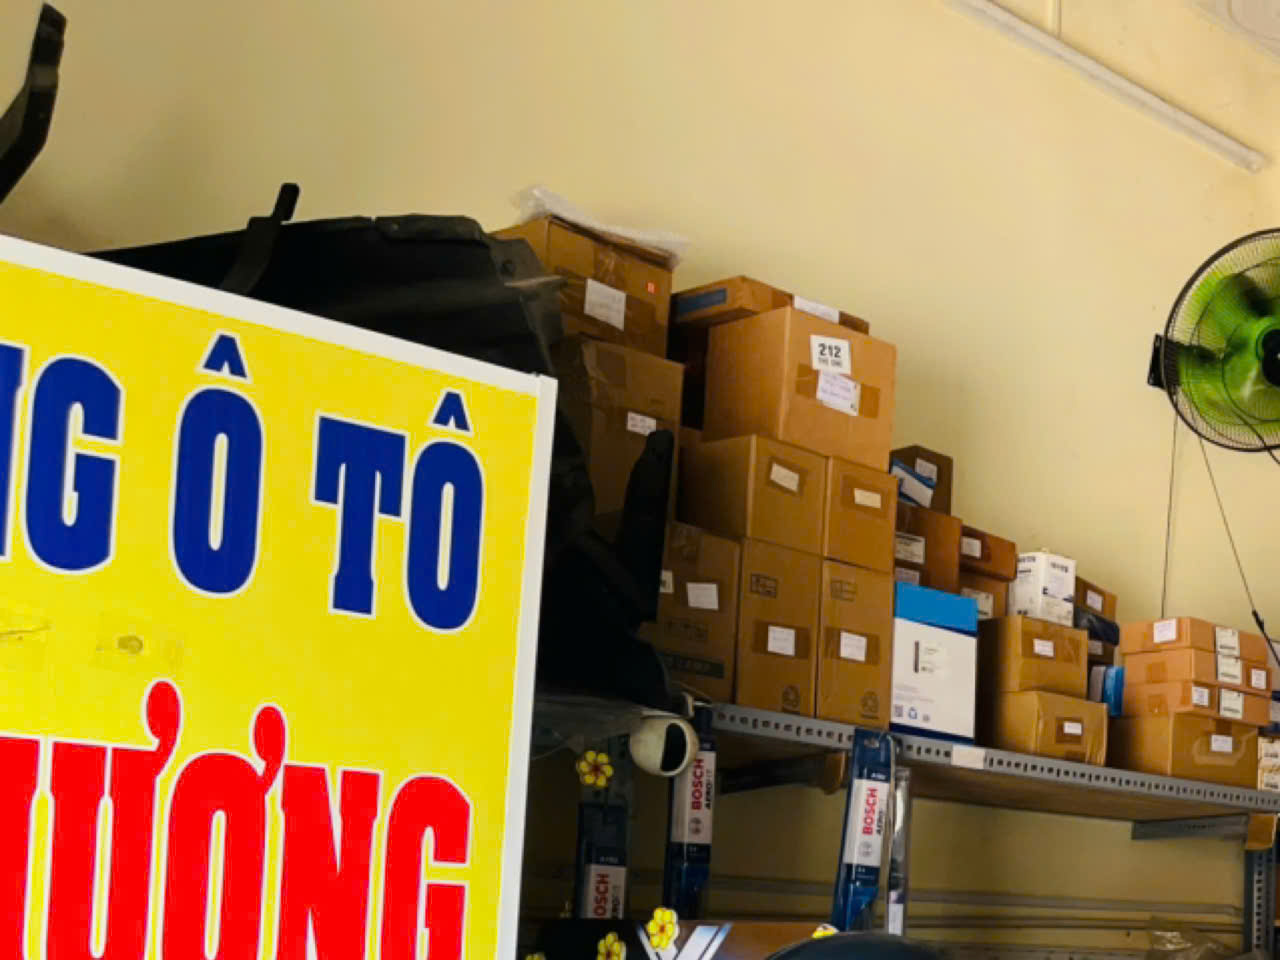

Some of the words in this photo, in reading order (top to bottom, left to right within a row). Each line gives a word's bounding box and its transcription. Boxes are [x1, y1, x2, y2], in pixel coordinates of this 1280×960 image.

[0, 342, 121, 571] G
[172, 334, 263, 594] Ô
[314, 391, 483, 629] TÔ
[691, 758, 705, 811] BOSCH
[862, 786, 879, 836] BOSCH
